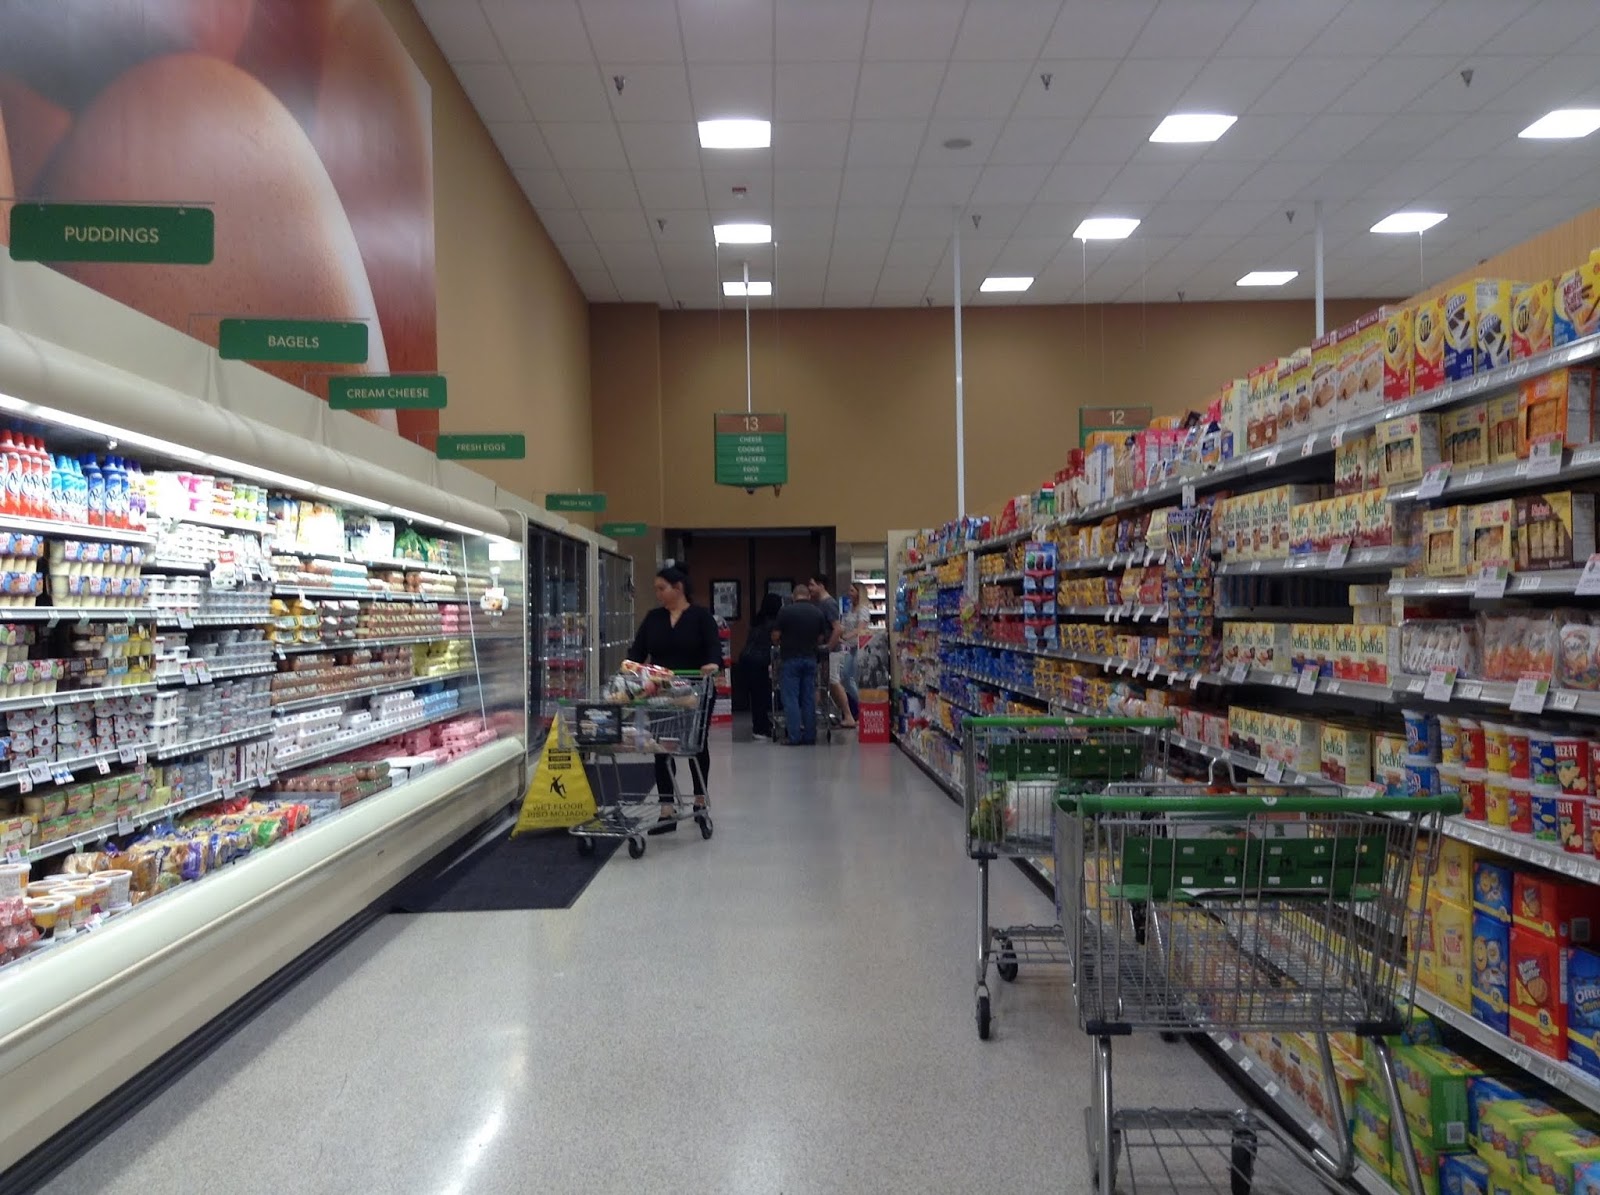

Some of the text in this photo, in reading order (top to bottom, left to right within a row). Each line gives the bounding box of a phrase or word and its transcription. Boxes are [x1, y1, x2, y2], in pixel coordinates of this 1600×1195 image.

[64, 226, 160, 243] PUDDINGS
[268, 335, 320, 349] BAGELS
[346, 388, 429, 399] CREAM CHEESE
[743, 416, 759, 431] 13
[1109, 410, 1125, 425] 12
[456, 442, 506, 452] FRESH EGGS
[533, 803, 551, 812] WET
[550, 810, 588, 818] MOJADO
[1539, 1012, 1549, 1026] 18
